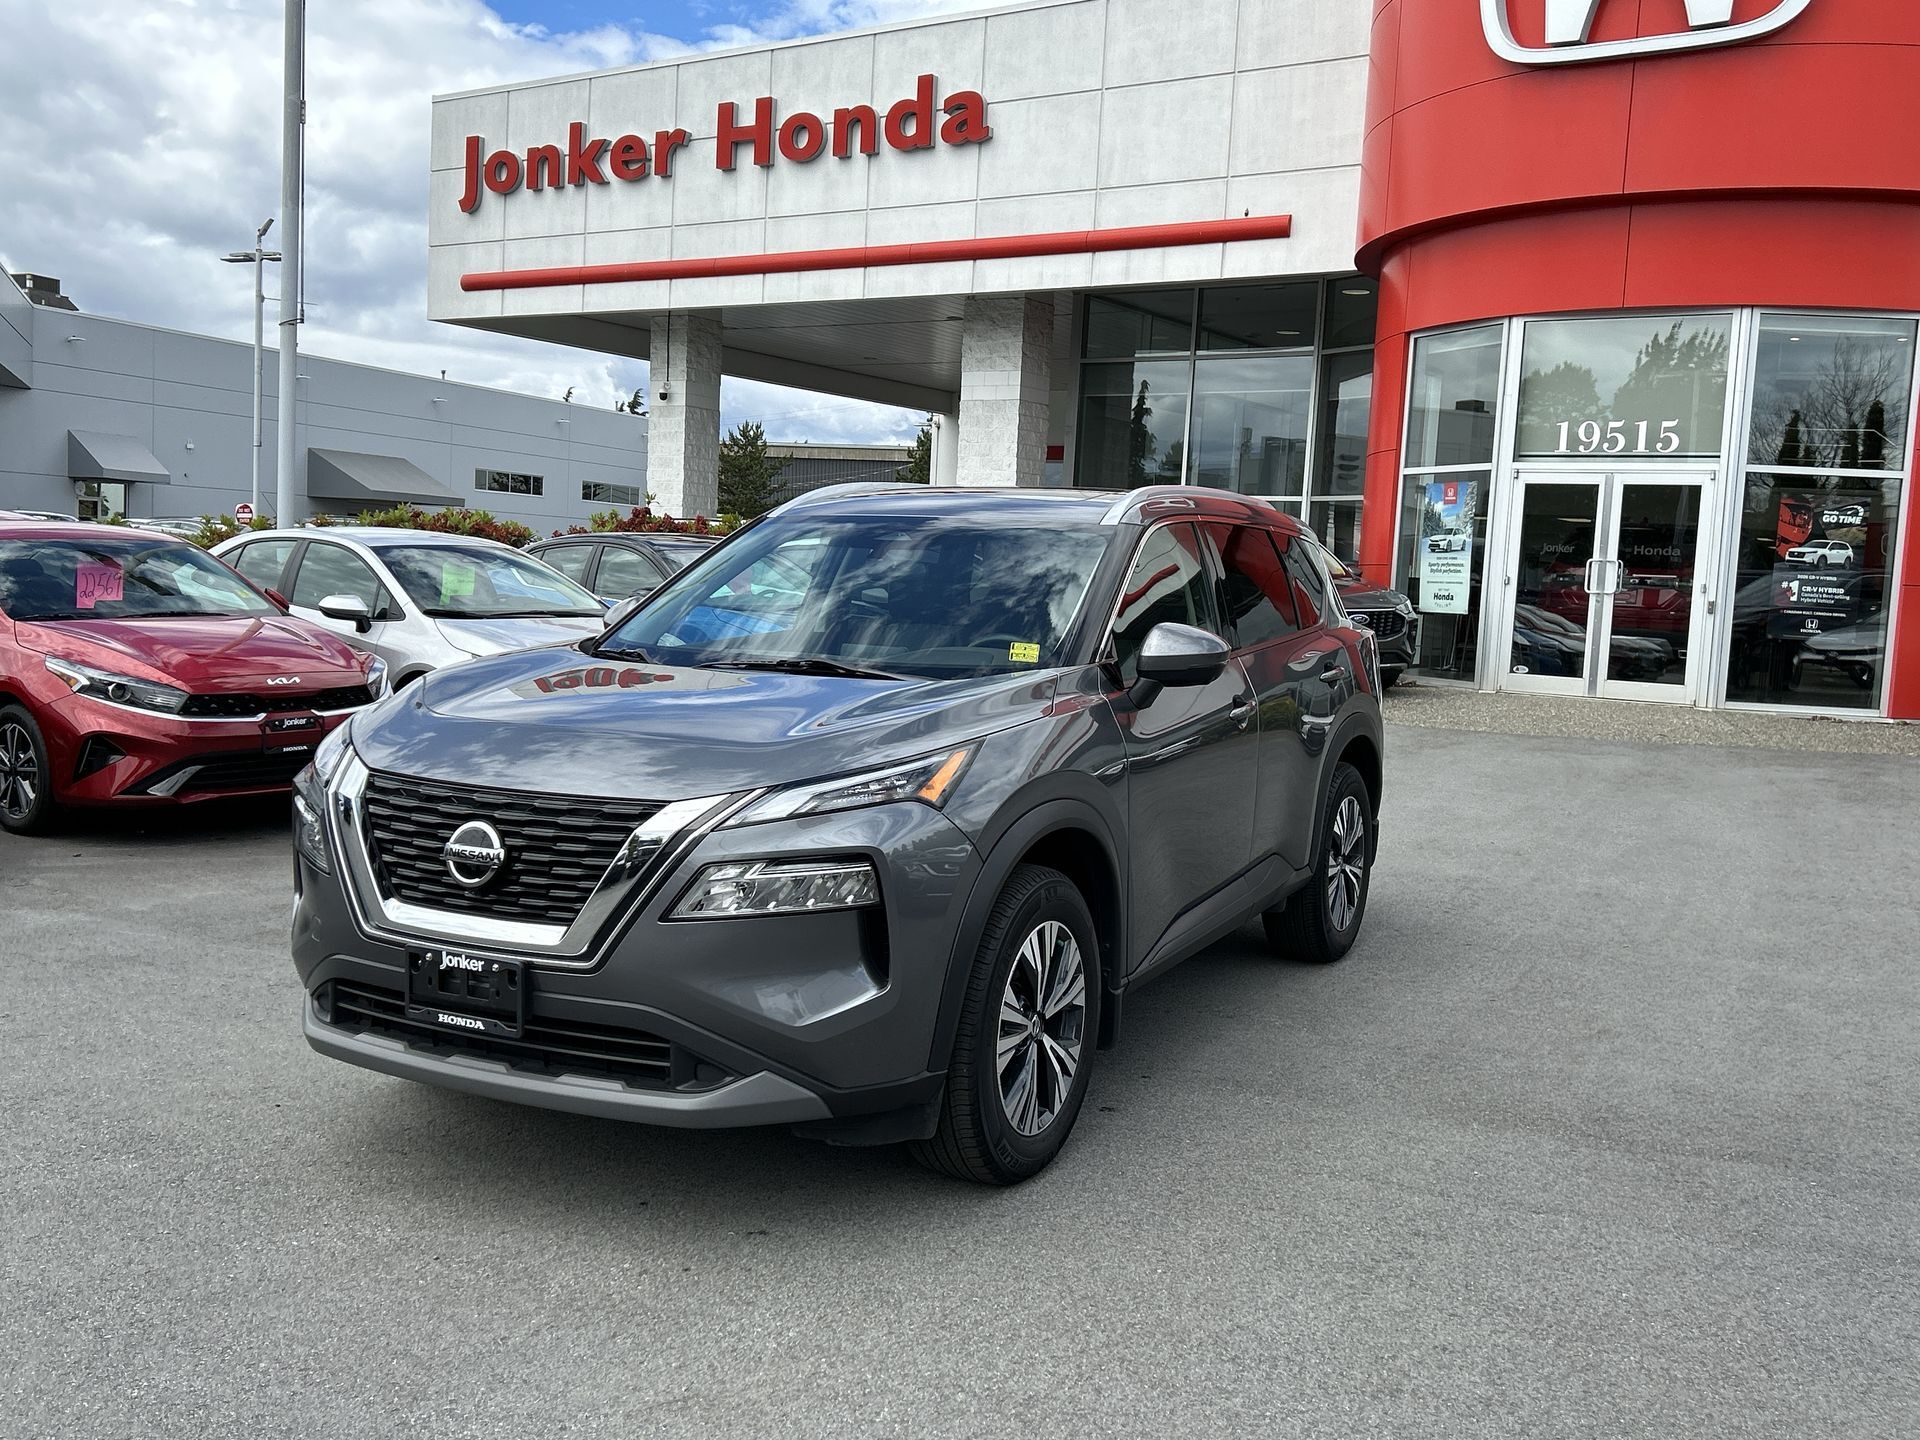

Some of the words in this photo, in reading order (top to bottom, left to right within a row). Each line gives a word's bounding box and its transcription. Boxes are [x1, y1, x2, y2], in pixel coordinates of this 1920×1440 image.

[458, 121, 692, 214] Jonker
[716, 73, 993, 171] Honda
[1554, 418, 1681, 453] 19515
[1822, 514, 1838, 523] GO
[1838, 515, 1863, 525] TIME
[1540, 543, 1575, 555] Jonker
[1634, 545, 1681, 556] Honda
[80, 572, 122, 599] 22569
[1433, 592, 1454, 601] Honda
[266, 676, 300, 685] KIA
[283, 717, 307, 728] Jonker
[449, 847, 496, 862] NISSAN
[439, 950, 485, 972] Jonker
[437, 1013, 486, 1030] HONDA
